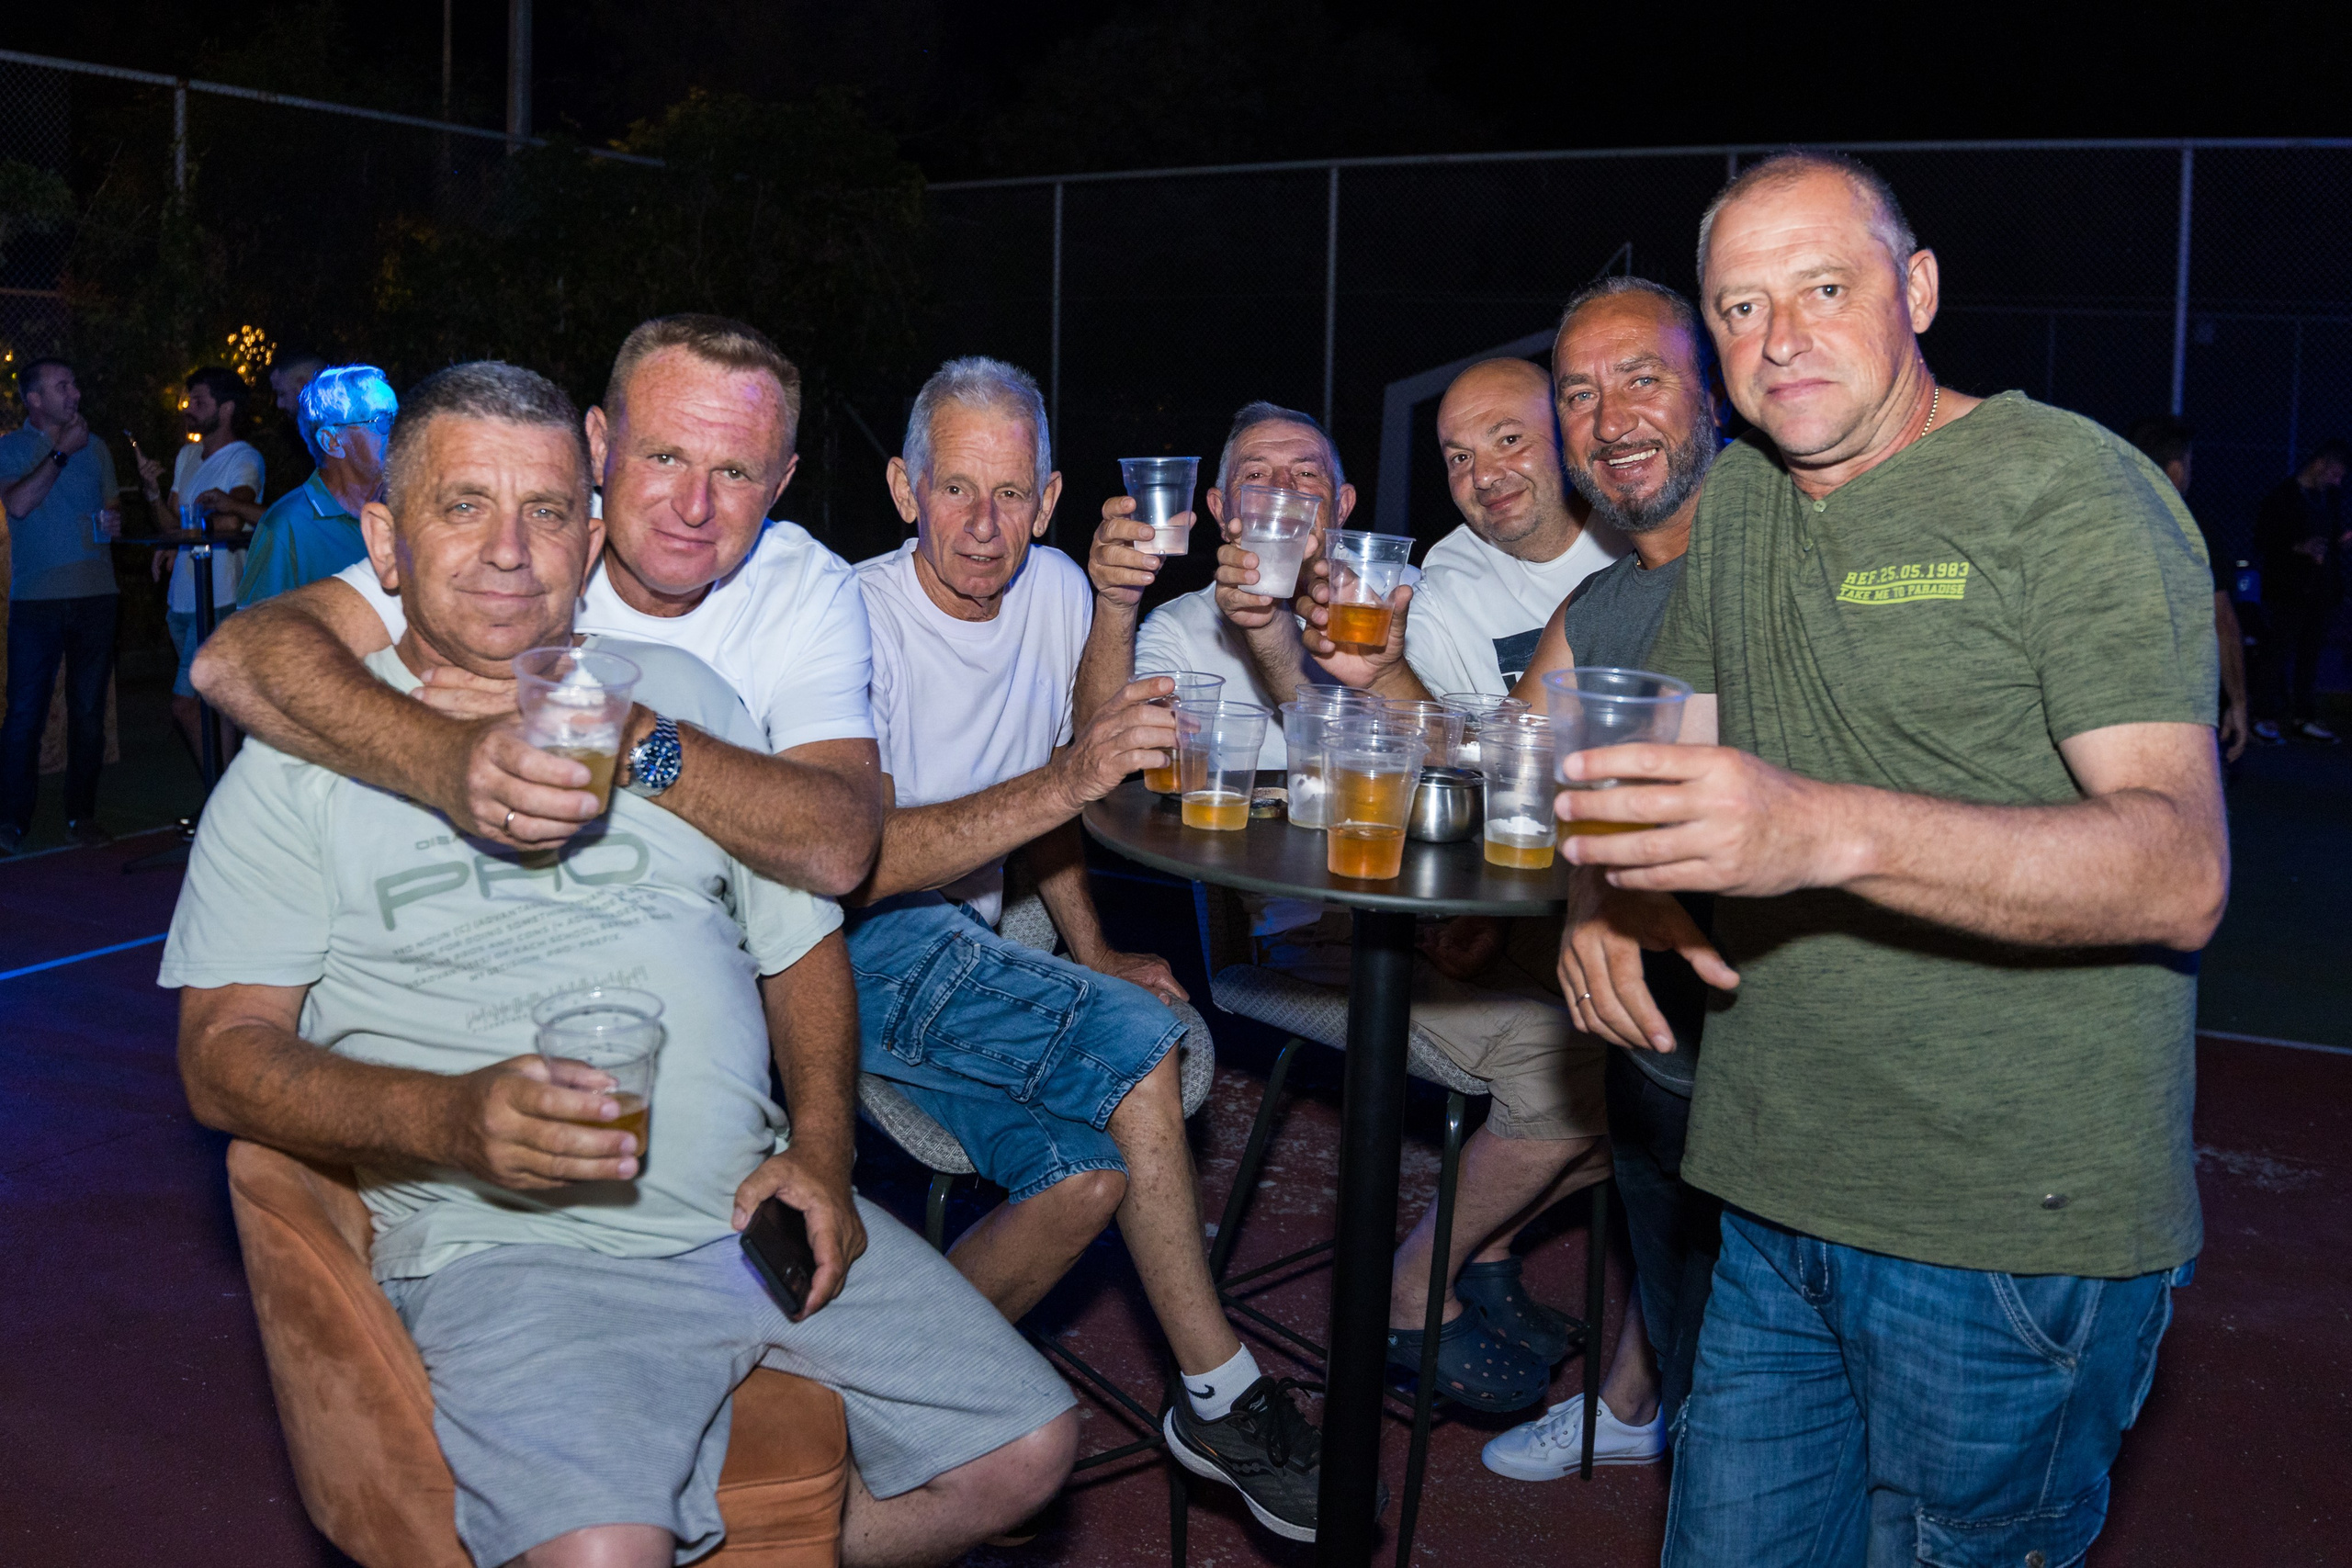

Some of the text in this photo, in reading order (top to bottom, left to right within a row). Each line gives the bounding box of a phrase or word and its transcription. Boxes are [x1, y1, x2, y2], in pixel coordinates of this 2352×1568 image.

[1839, 583, 1965, 600] TAKE ME TO PARADISE
